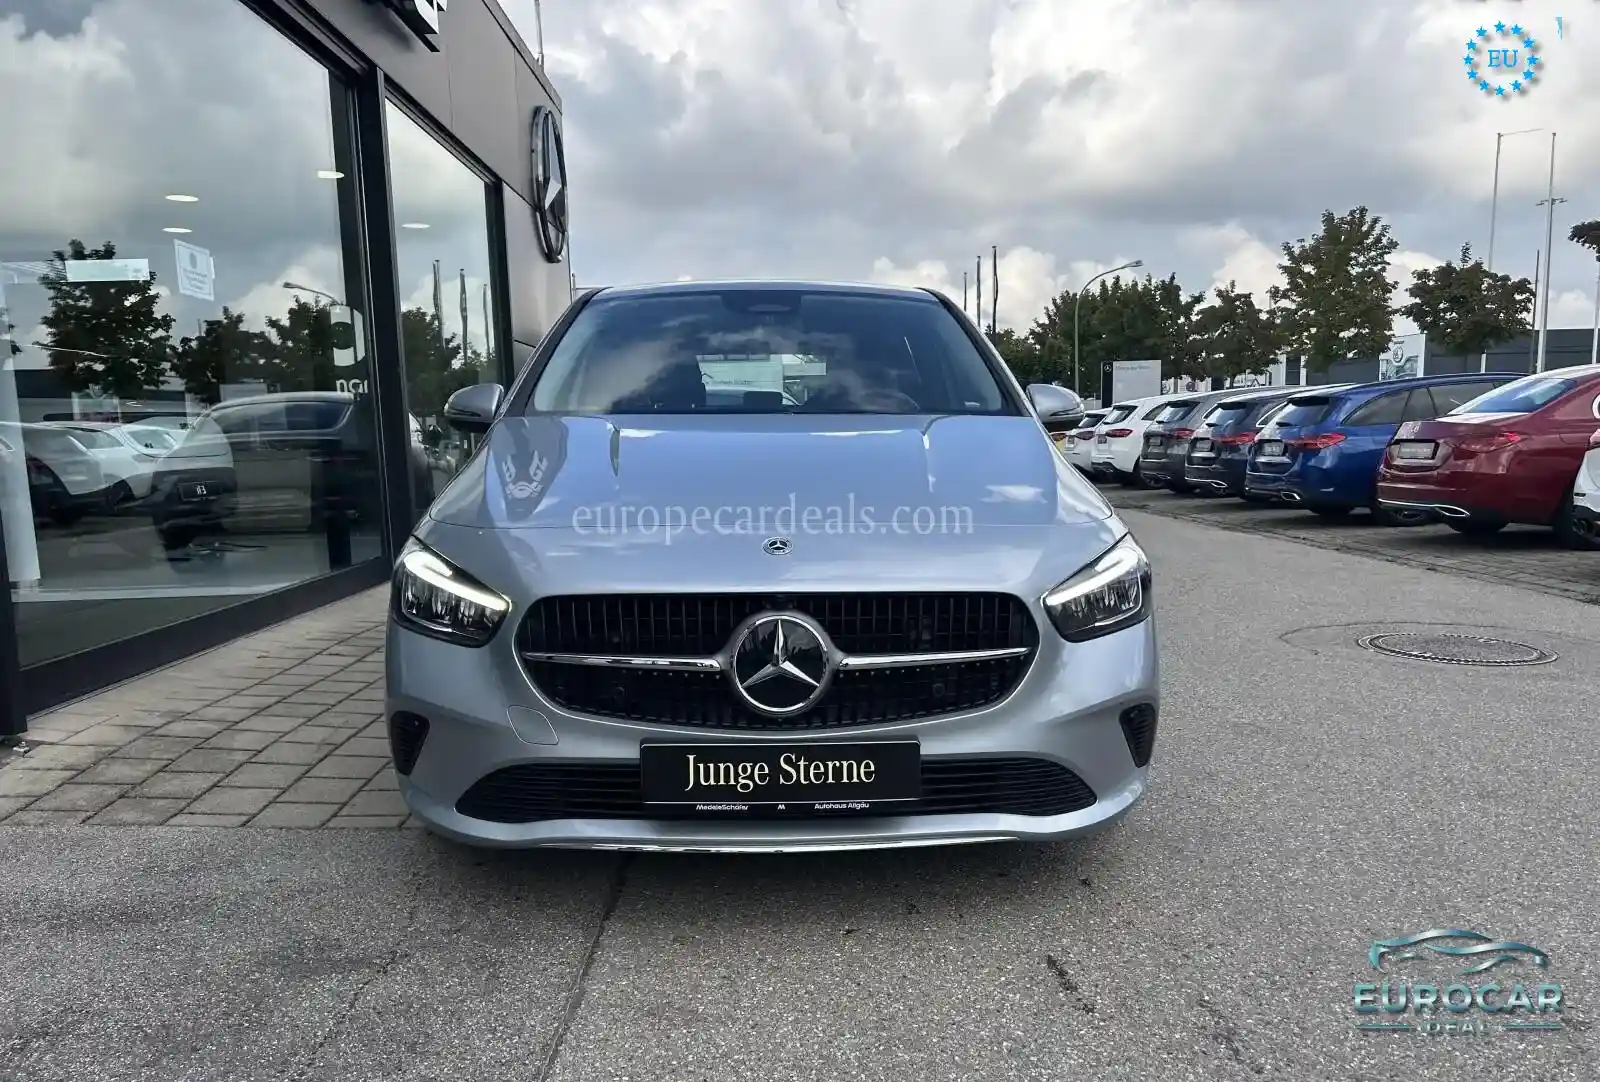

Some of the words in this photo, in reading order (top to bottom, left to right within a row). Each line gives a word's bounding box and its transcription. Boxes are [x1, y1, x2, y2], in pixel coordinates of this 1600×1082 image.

[684, 753, 770, 793] Junge
[779, 752, 876, 786] Sterne
[814, 802, 848, 810] Autohaus
